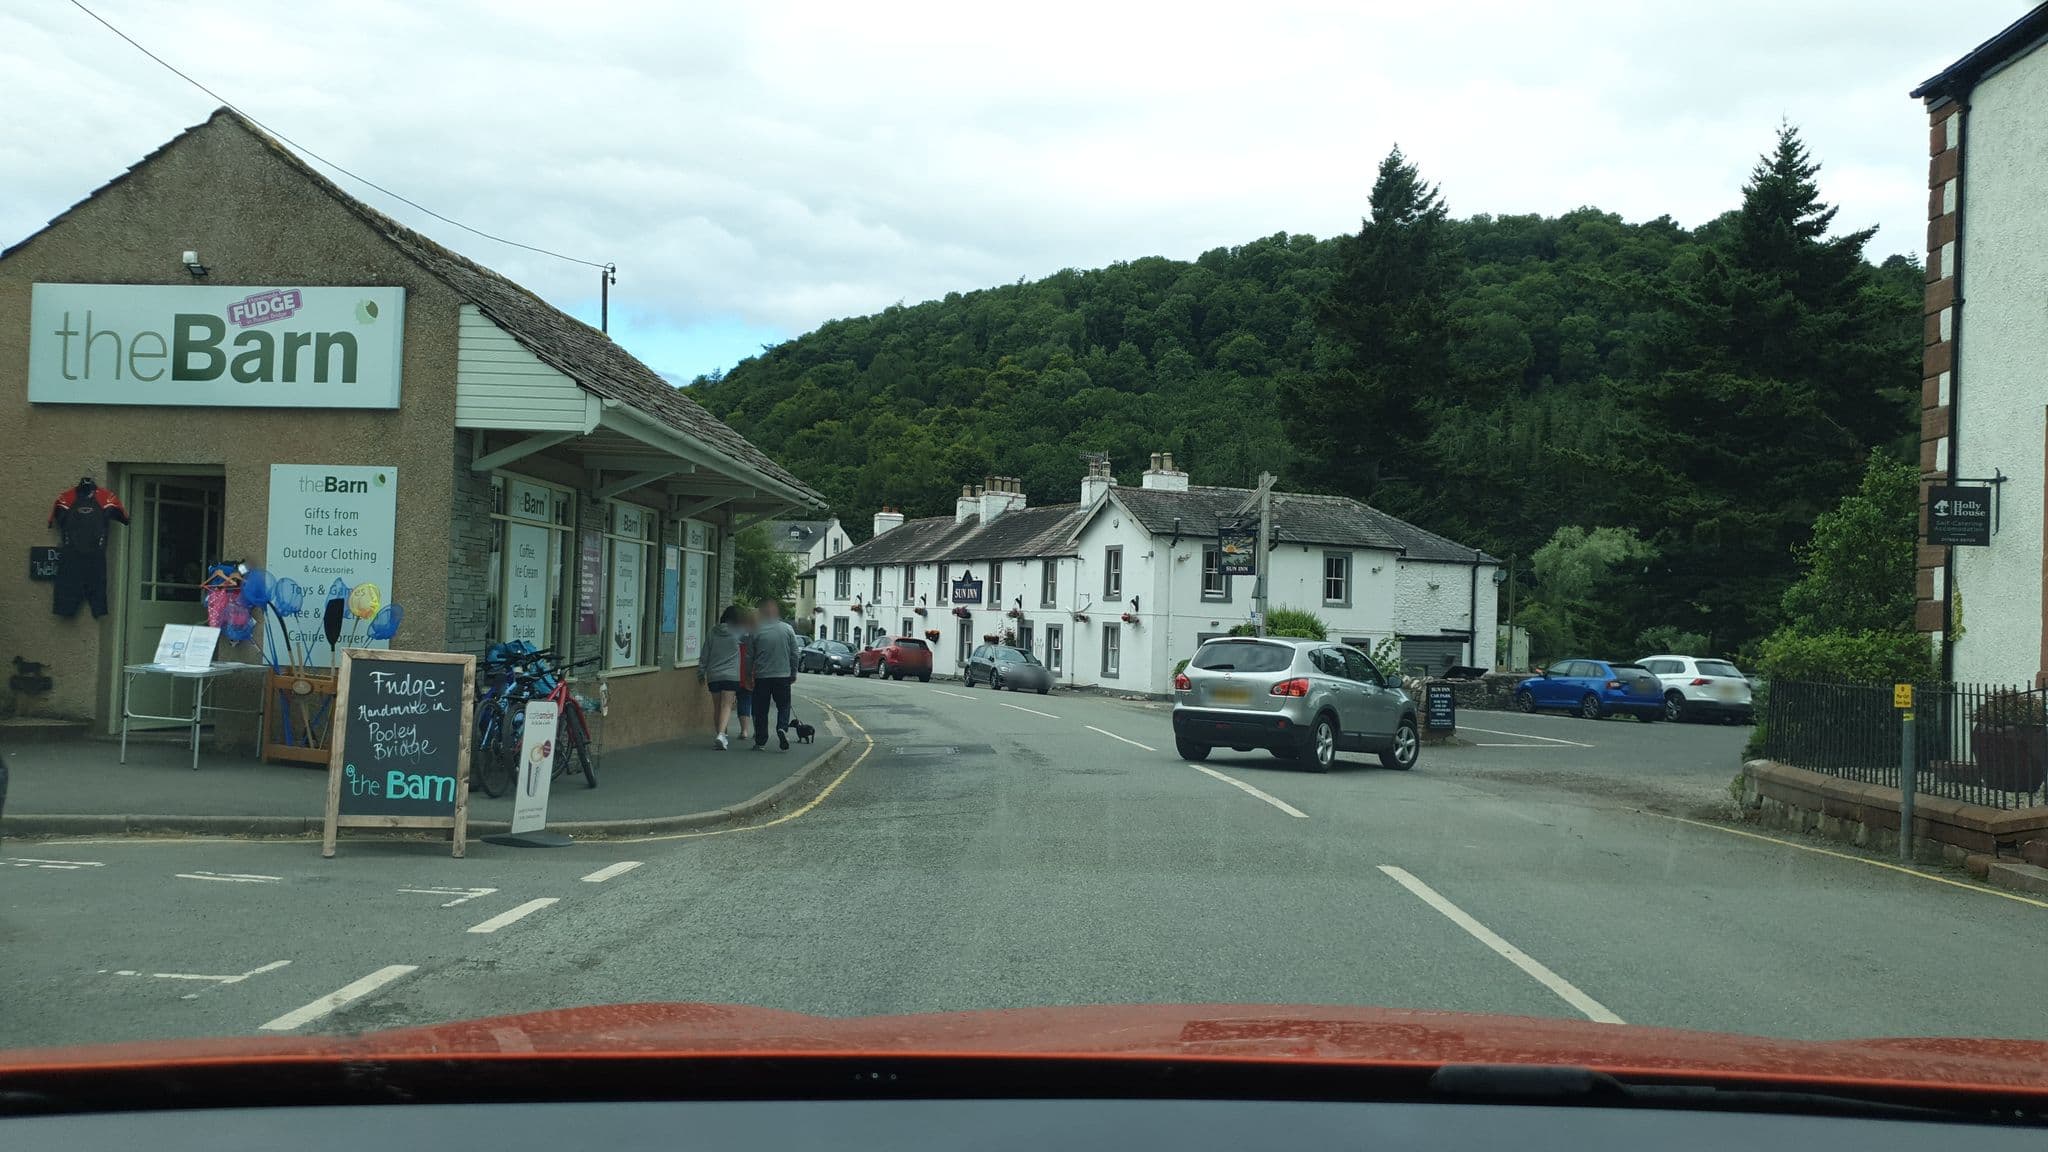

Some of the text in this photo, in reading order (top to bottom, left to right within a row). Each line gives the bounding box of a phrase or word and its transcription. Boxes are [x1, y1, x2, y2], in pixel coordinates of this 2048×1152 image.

[233, 294, 296, 321] FUDGE
[54, 309, 359, 384] theBarn
[299, 475, 369, 494] theBarn
[1953, 500, 1981, 511] Holly
[304, 507, 359, 520] Gifts from
[1953, 509, 1986, 517] House
[304, 523, 359, 537] The Lakes
[283, 546, 378, 564] Outdoor Clothing
[303, 564, 355, 575] & Accessories
[523, 565, 539, 579] Cream
[290, 583, 314, 597] Toys
[317, 584, 326, 596] &
[954, 588, 977, 599] SUN INN
[313, 607, 321, 618] &
[288, 630, 325, 643] Canine
[358, 699, 452, 722] Handmade in
[369, 722, 417, 746] Pooley
[373, 739, 437, 765] Bridge
[350, 770, 456, 803] the Barn
